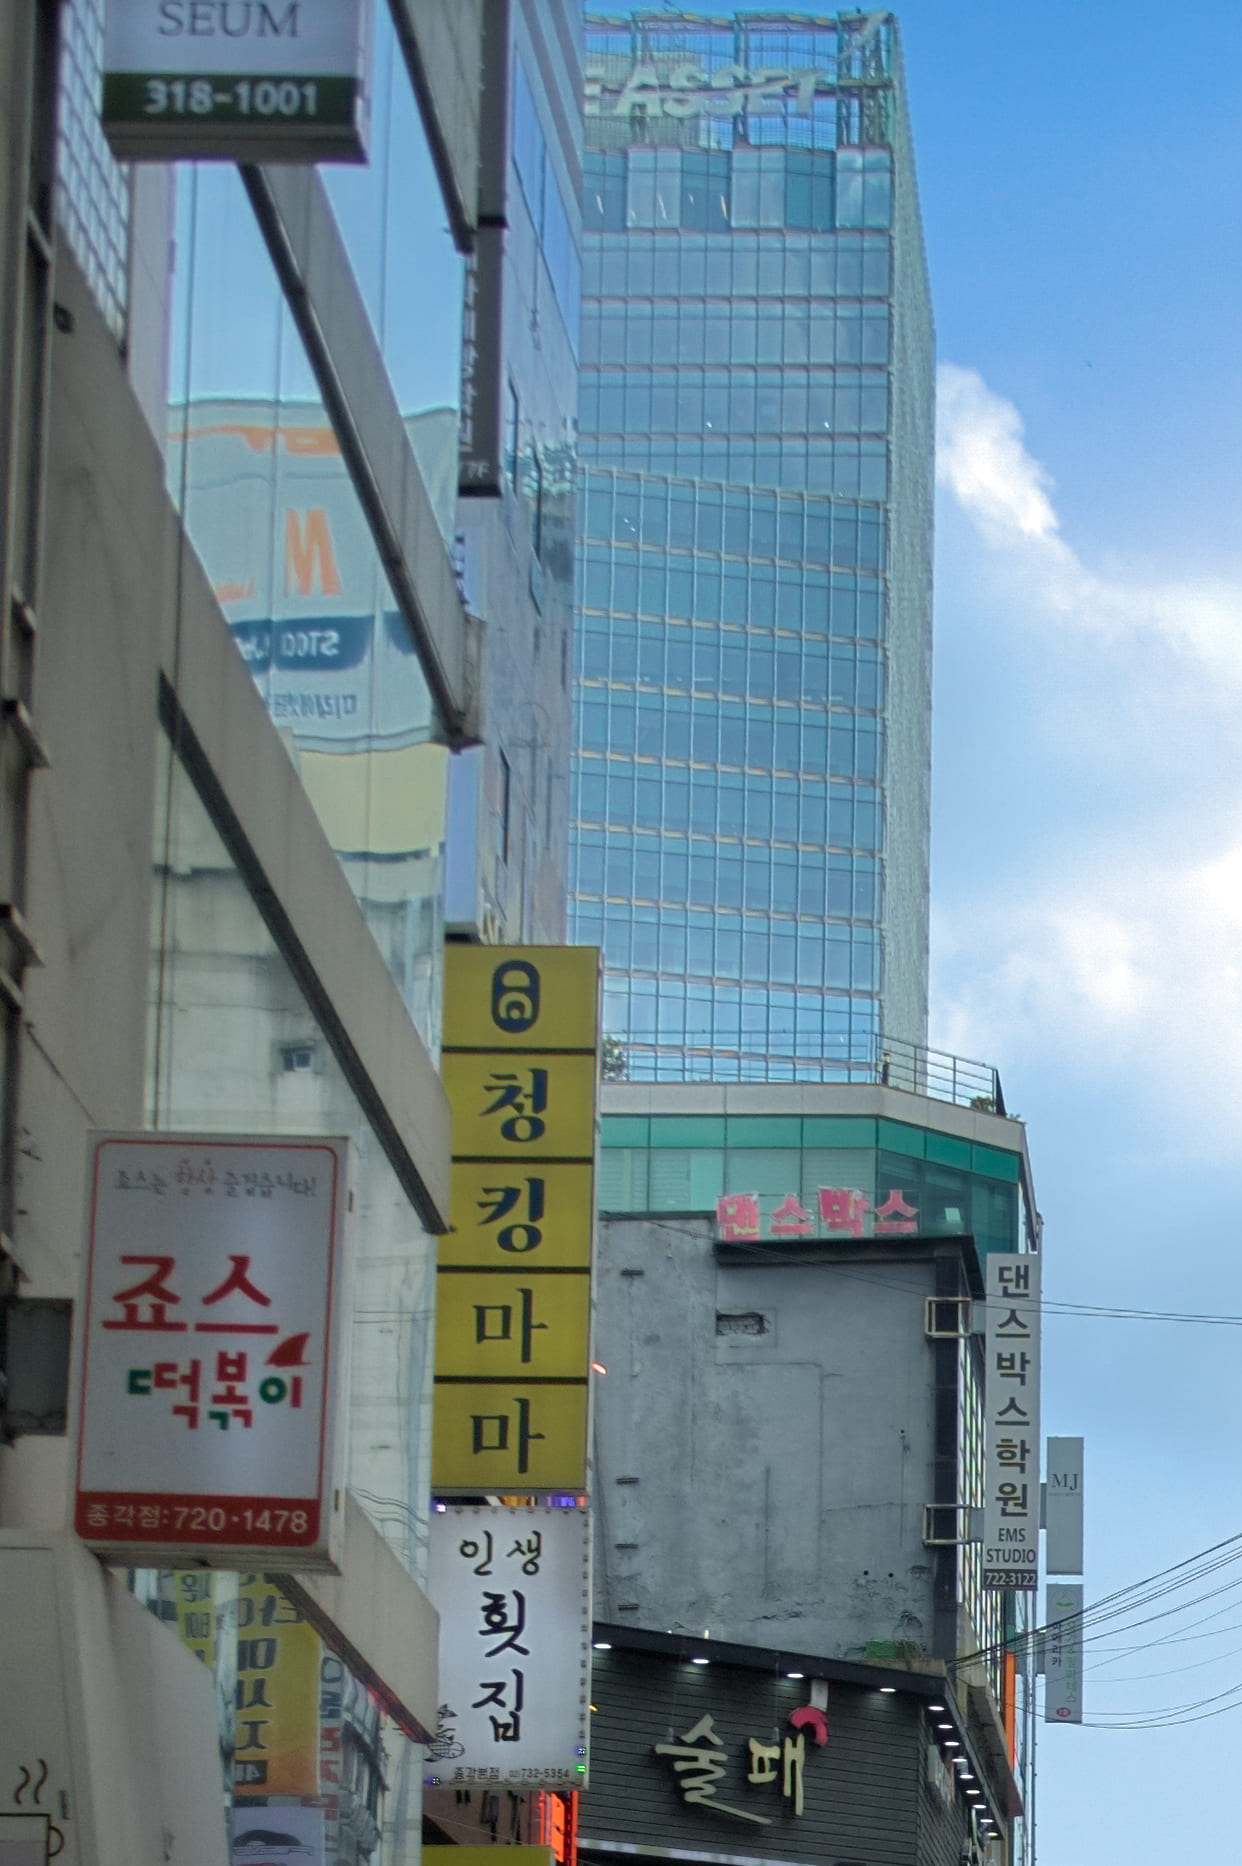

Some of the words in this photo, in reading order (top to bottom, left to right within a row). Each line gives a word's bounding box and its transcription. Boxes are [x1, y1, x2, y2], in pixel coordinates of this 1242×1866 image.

[158, 1, 300, 38] SEUM
[145, 79, 318, 116] 318-1001
[103, 1254, 279, 1336] 죠스
[994, 1263, 1031, 1520] 댄스박스학원
[1050, 1472, 1079, 1493] MJ
[458, 1529, 544, 1578] 인생
[996, 1527, 1027, 1545] EMS
[985, 1547, 1037, 1565] STUDIO
[985, 1570, 1037, 1588] 722-3122
[471, 1589, 532, 1744] 횟집
